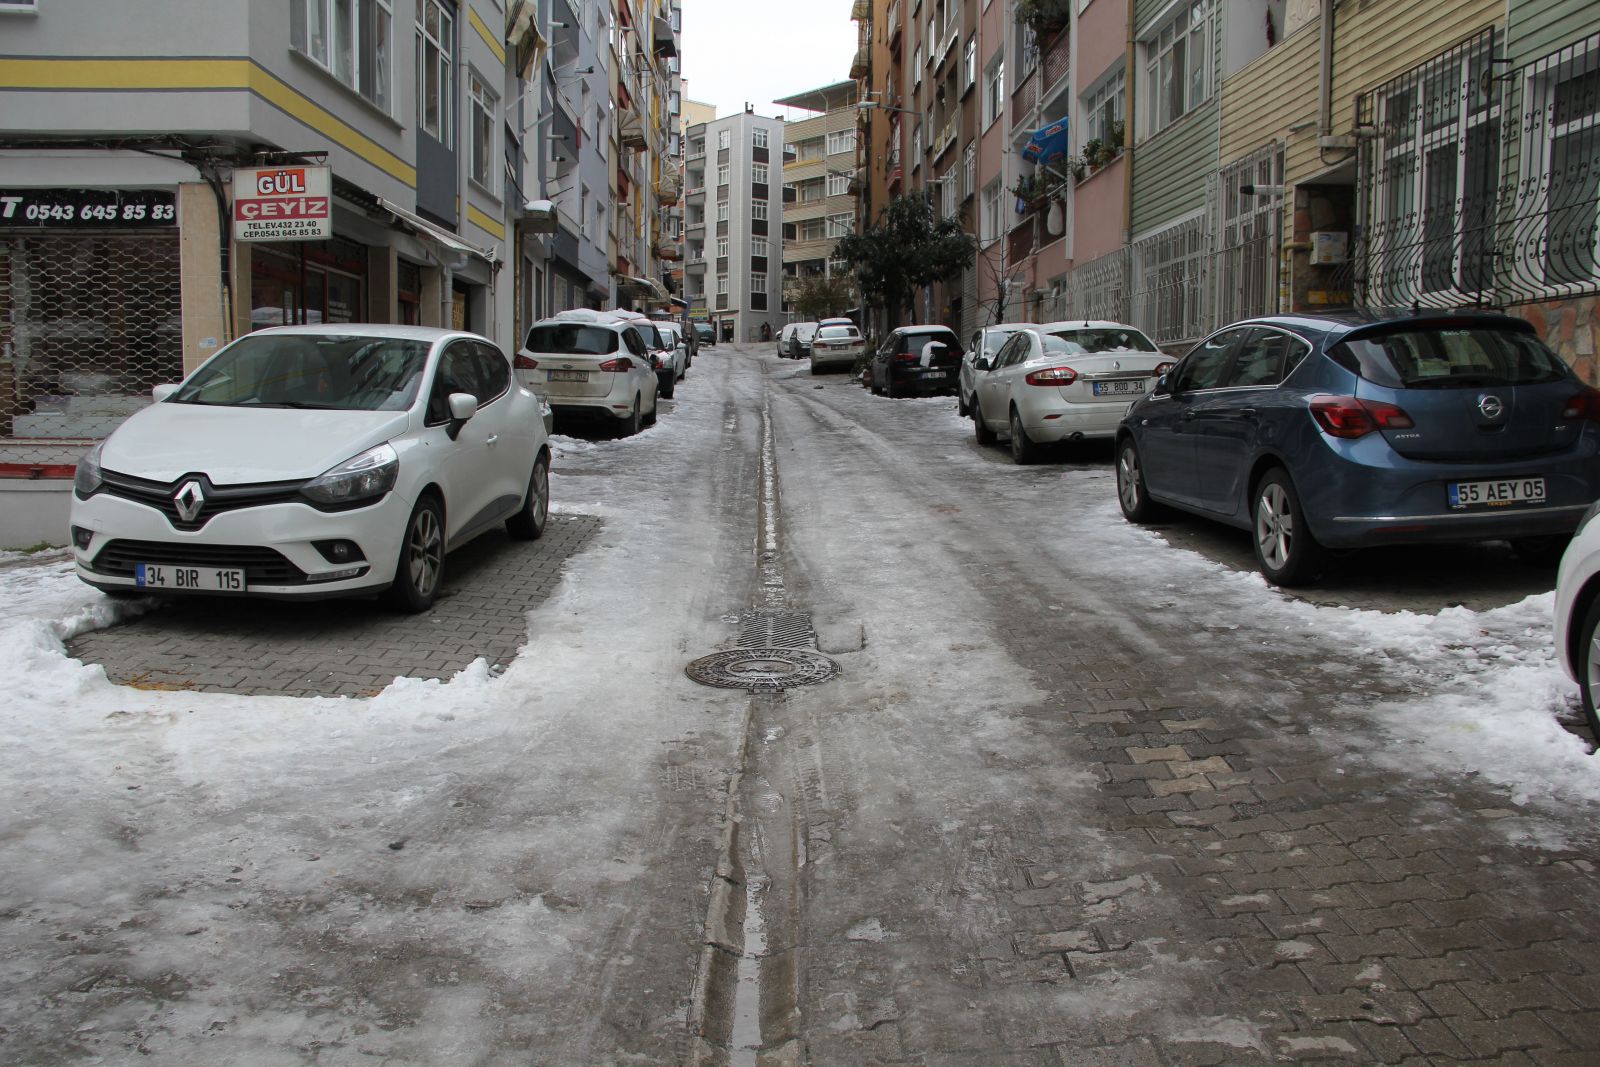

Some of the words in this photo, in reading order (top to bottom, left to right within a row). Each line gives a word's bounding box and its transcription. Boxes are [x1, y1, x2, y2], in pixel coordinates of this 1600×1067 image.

[258, 171, 305, 194] GÜL
[26, 204, 74, 220] 0543
[80, 204, 118, 220] 645
[122, 204, 146, 220] 85
[151, 204, 175, 220] 83
[241, 198, 326, 220] ÇEYİZ
[243, 230, 280, 238] CEP.0543
[282, 229, 297, 237] 645
[295, 221, 304, 229] 23
[306, 220, 317, 228] 40
[1099, 382, 1109, 391] 55
[1133, 381, 1143, 390] 34
[1458, 484, 1479, 502] 55
[1487, 481, 1518, 500] AEY
[1523, 480, 1544, 498] 05
[147, 567, 165, 586] 34
[176, 568, 199, 587] BIR
[216, 570, 240, 589] 115
